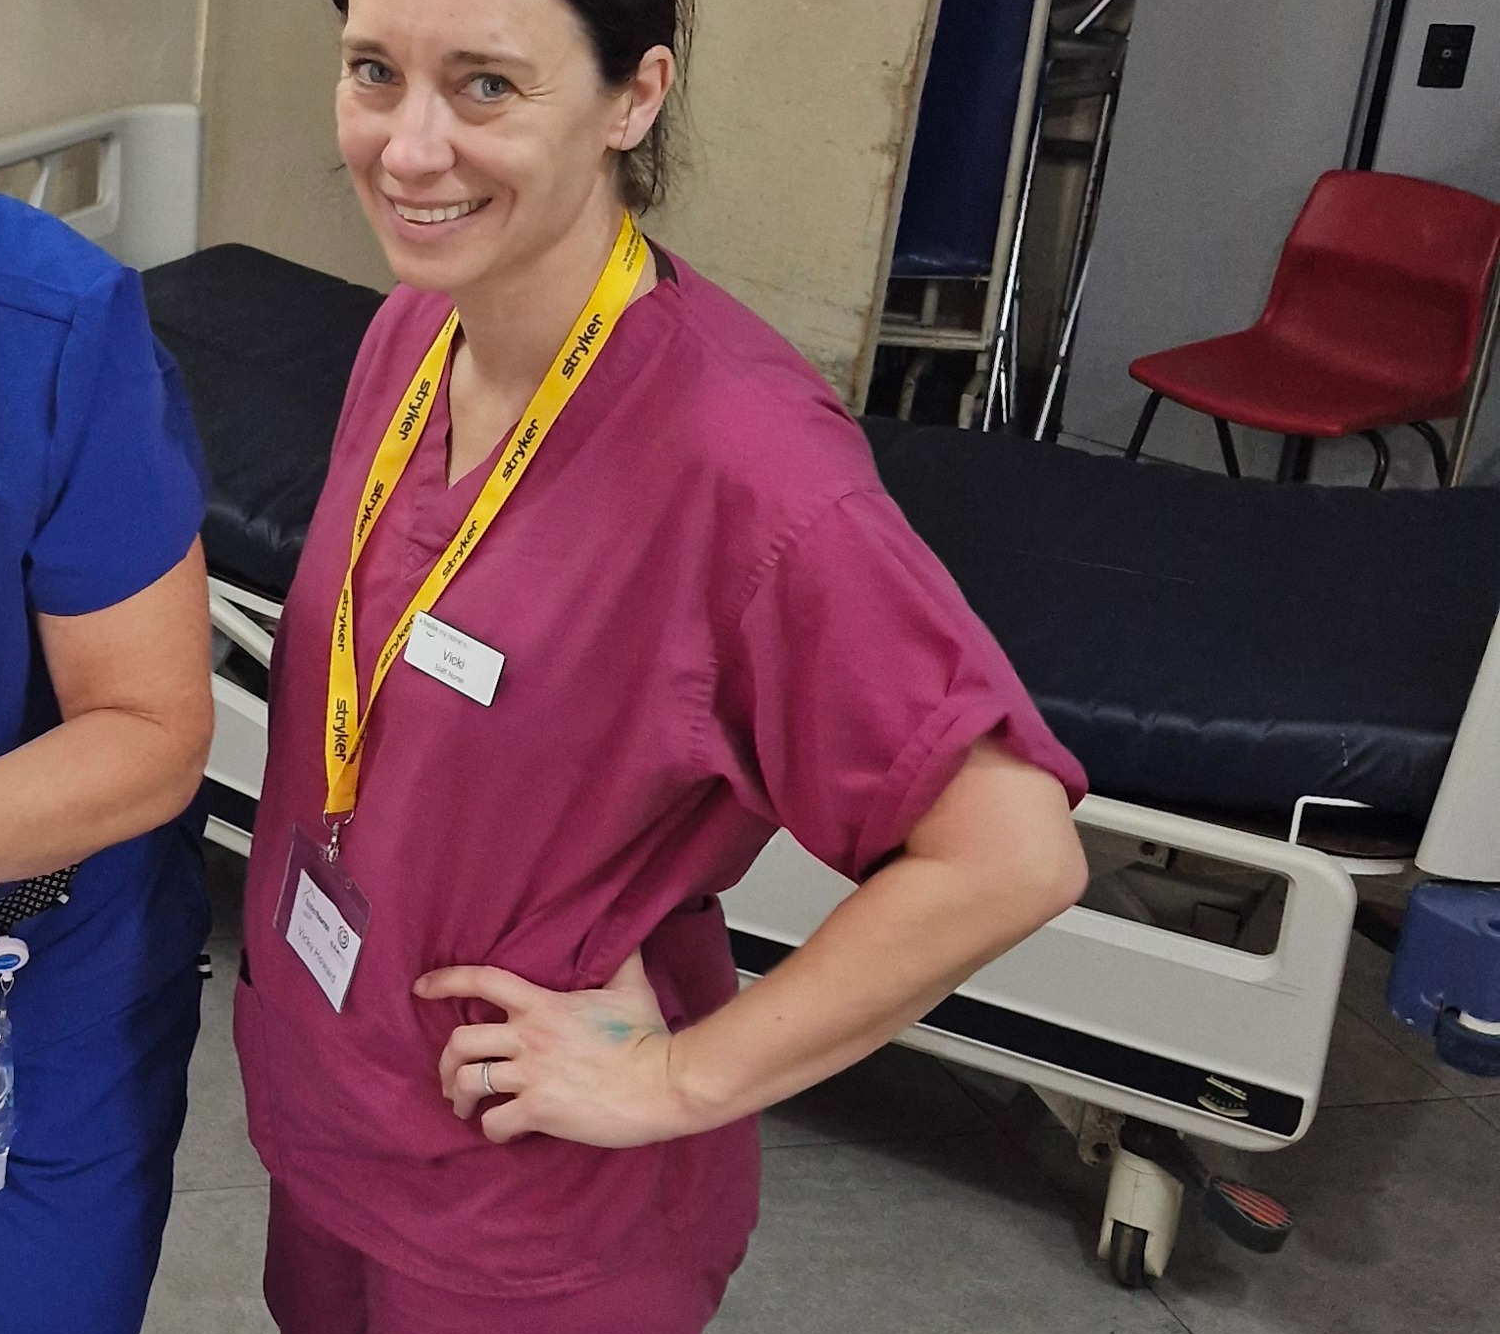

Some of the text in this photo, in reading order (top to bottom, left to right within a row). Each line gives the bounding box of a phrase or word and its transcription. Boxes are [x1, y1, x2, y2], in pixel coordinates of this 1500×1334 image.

[561, 313, 604, 380] stryker
[398, 377, 431, 441] stryker
[501, 418, 539, 483] stryker
[357, 479, 385, 543] stryker
[441, 520, 478, 579] stryker
[337, 588, 349, 653] stryker
[333, 697, 349, 763] stryker
